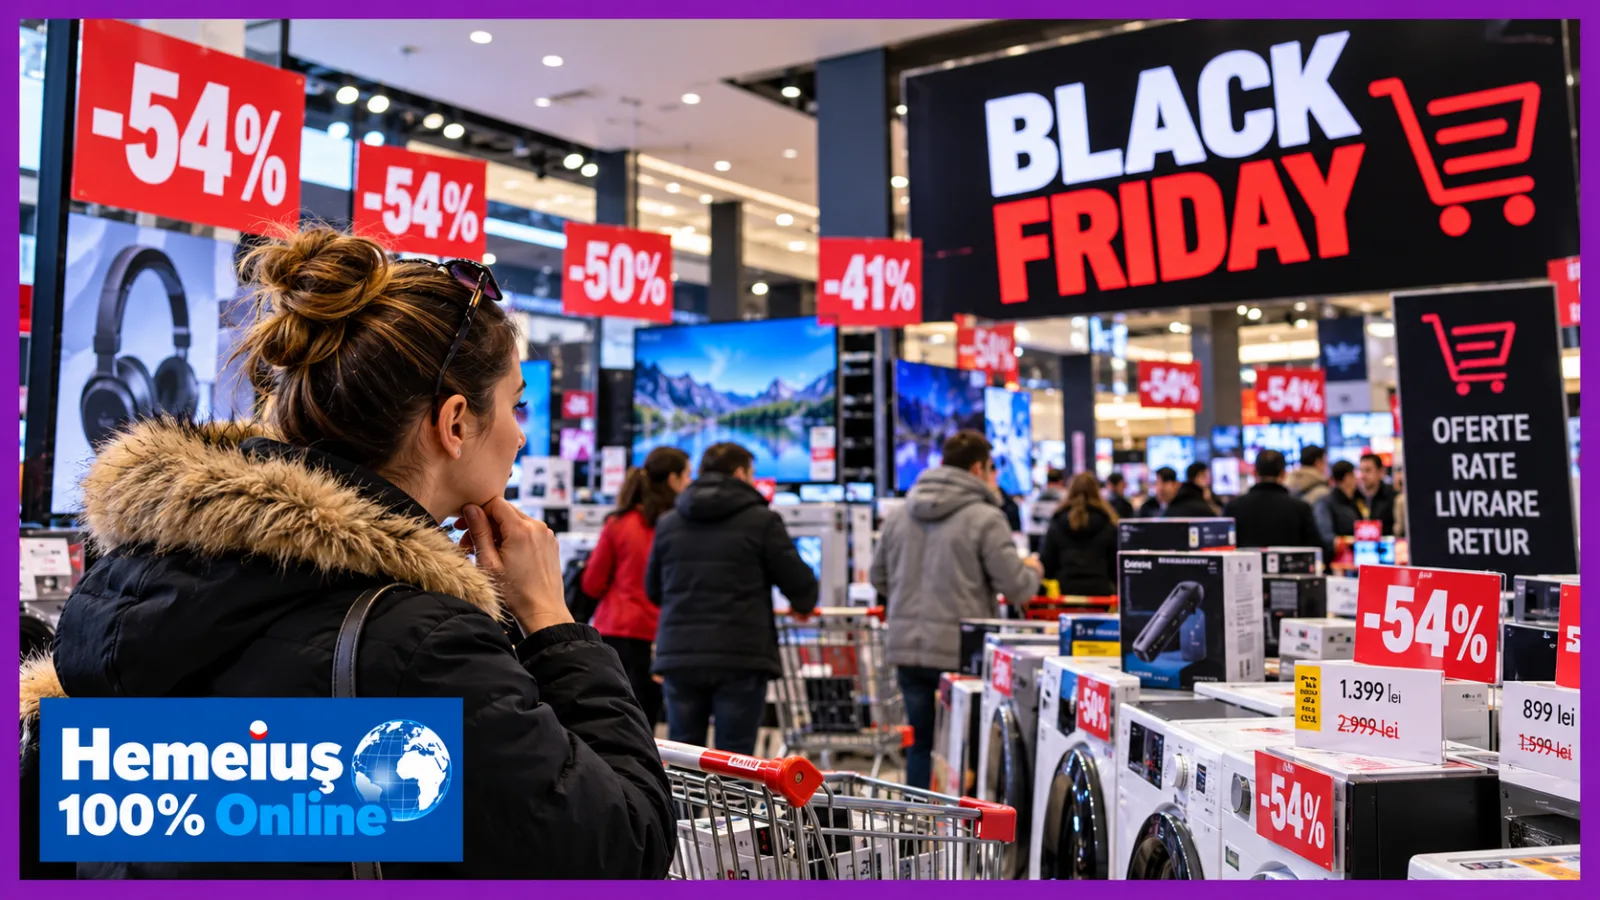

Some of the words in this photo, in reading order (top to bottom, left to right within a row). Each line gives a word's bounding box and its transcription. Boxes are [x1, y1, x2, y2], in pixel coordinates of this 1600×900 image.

[985, 31, 1362, 198] BLACK
[92, 62, 287, 206] -54%
[363, 166, 479, 243] -54%
[993, 143, 1366, 304] FRIDAY
[568, 240, 667, 306] -50%
[824, 253, 916, 311] -41%
[1140, 367, 1200, 404] -54%
[1257, 375, 1323, 413] -54%
[1432, 414, 1531, 444] OFERTE
[1452, 452, 1517, 480] RATE
[1436, 490, 1540, 517] LIVRARE
[1449, 528, 1530, 556] RETUR
[1363, 584, 1488, 664] -54%
[1340, 679, 1384, 702] 1.399
[1387, 683, 1402, 704] lei
[1337, 713, 1377, 736] 2.999
[1380, 719, 1400, 739] lei
[1523, 698, 1553, 723] 899
[1557, 703, 1575, 727] lei
[1519, 733, 1552, 755] 1.599
[1556, 741, 1572, 761] lei
[1260, 772, 1326, 850] -54%
